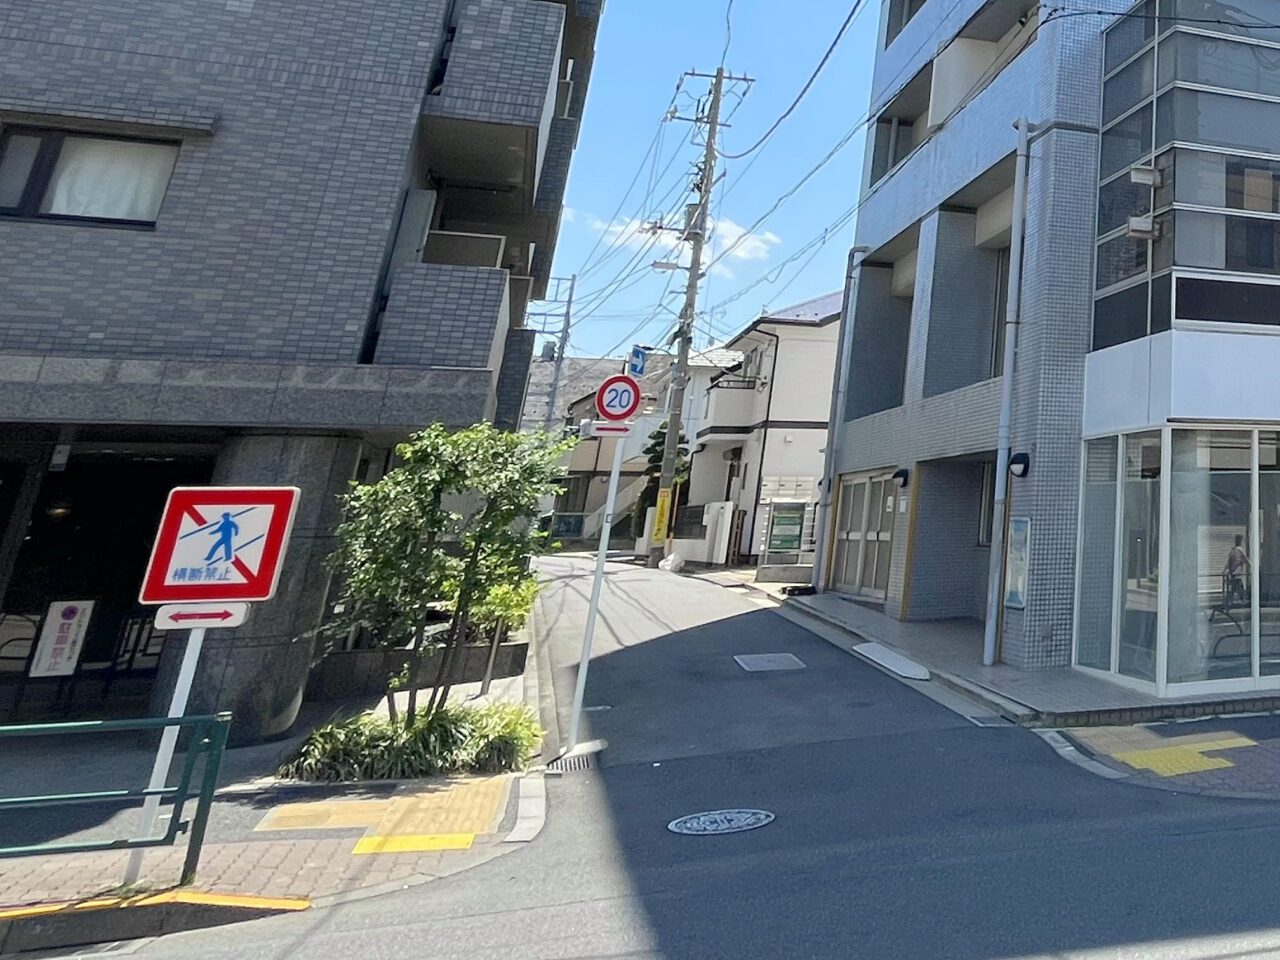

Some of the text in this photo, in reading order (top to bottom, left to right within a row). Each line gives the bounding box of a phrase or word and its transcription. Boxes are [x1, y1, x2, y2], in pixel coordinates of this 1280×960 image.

[605, 388, 631, 409] 20
[172, 566, 232, 581] 横断禁止
